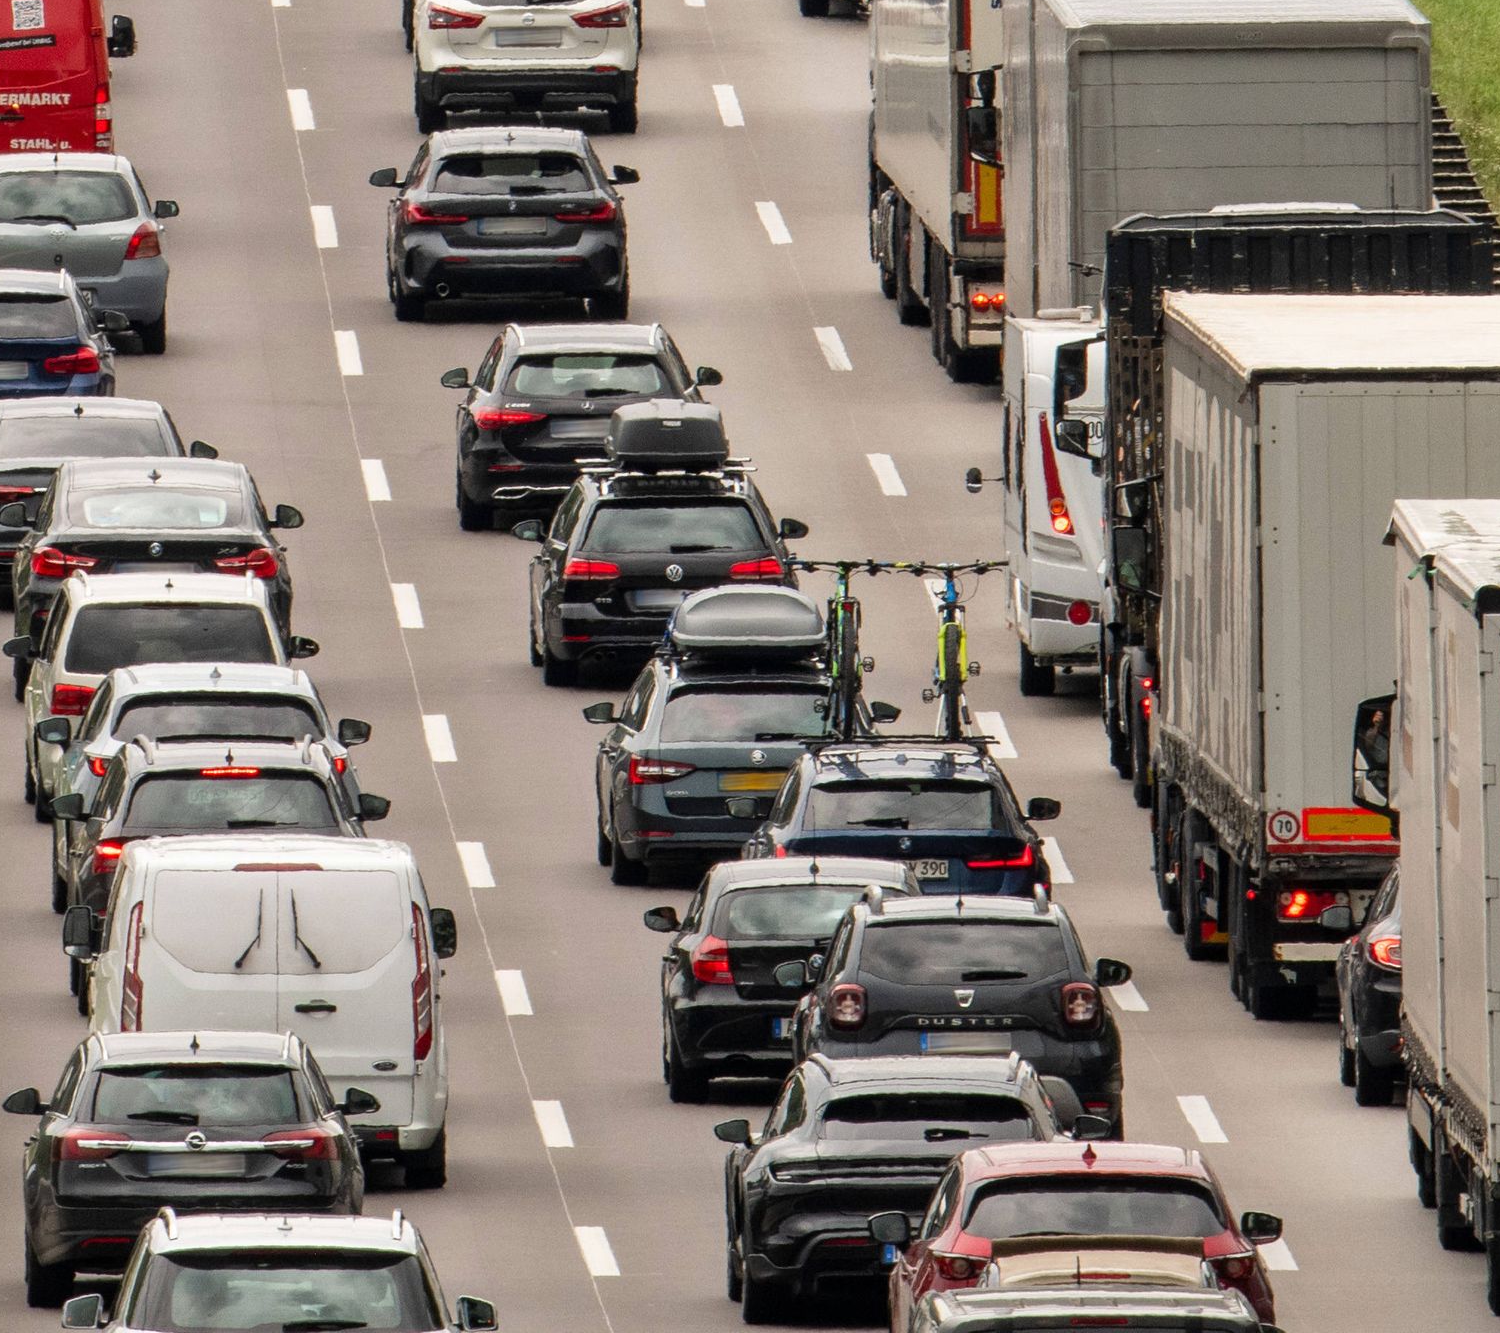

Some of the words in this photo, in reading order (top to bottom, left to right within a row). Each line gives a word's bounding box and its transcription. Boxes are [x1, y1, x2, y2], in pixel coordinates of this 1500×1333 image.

[10, 138, 57, 150] STAHL-
[60, 140, 72, 150] u.
[1087, 421, 1103, 440] 00
[1277, 819, 1293, 834] 70
[920, 861, 947, 876] 390
[917, 1018, 1012, 1026] DUSTER
